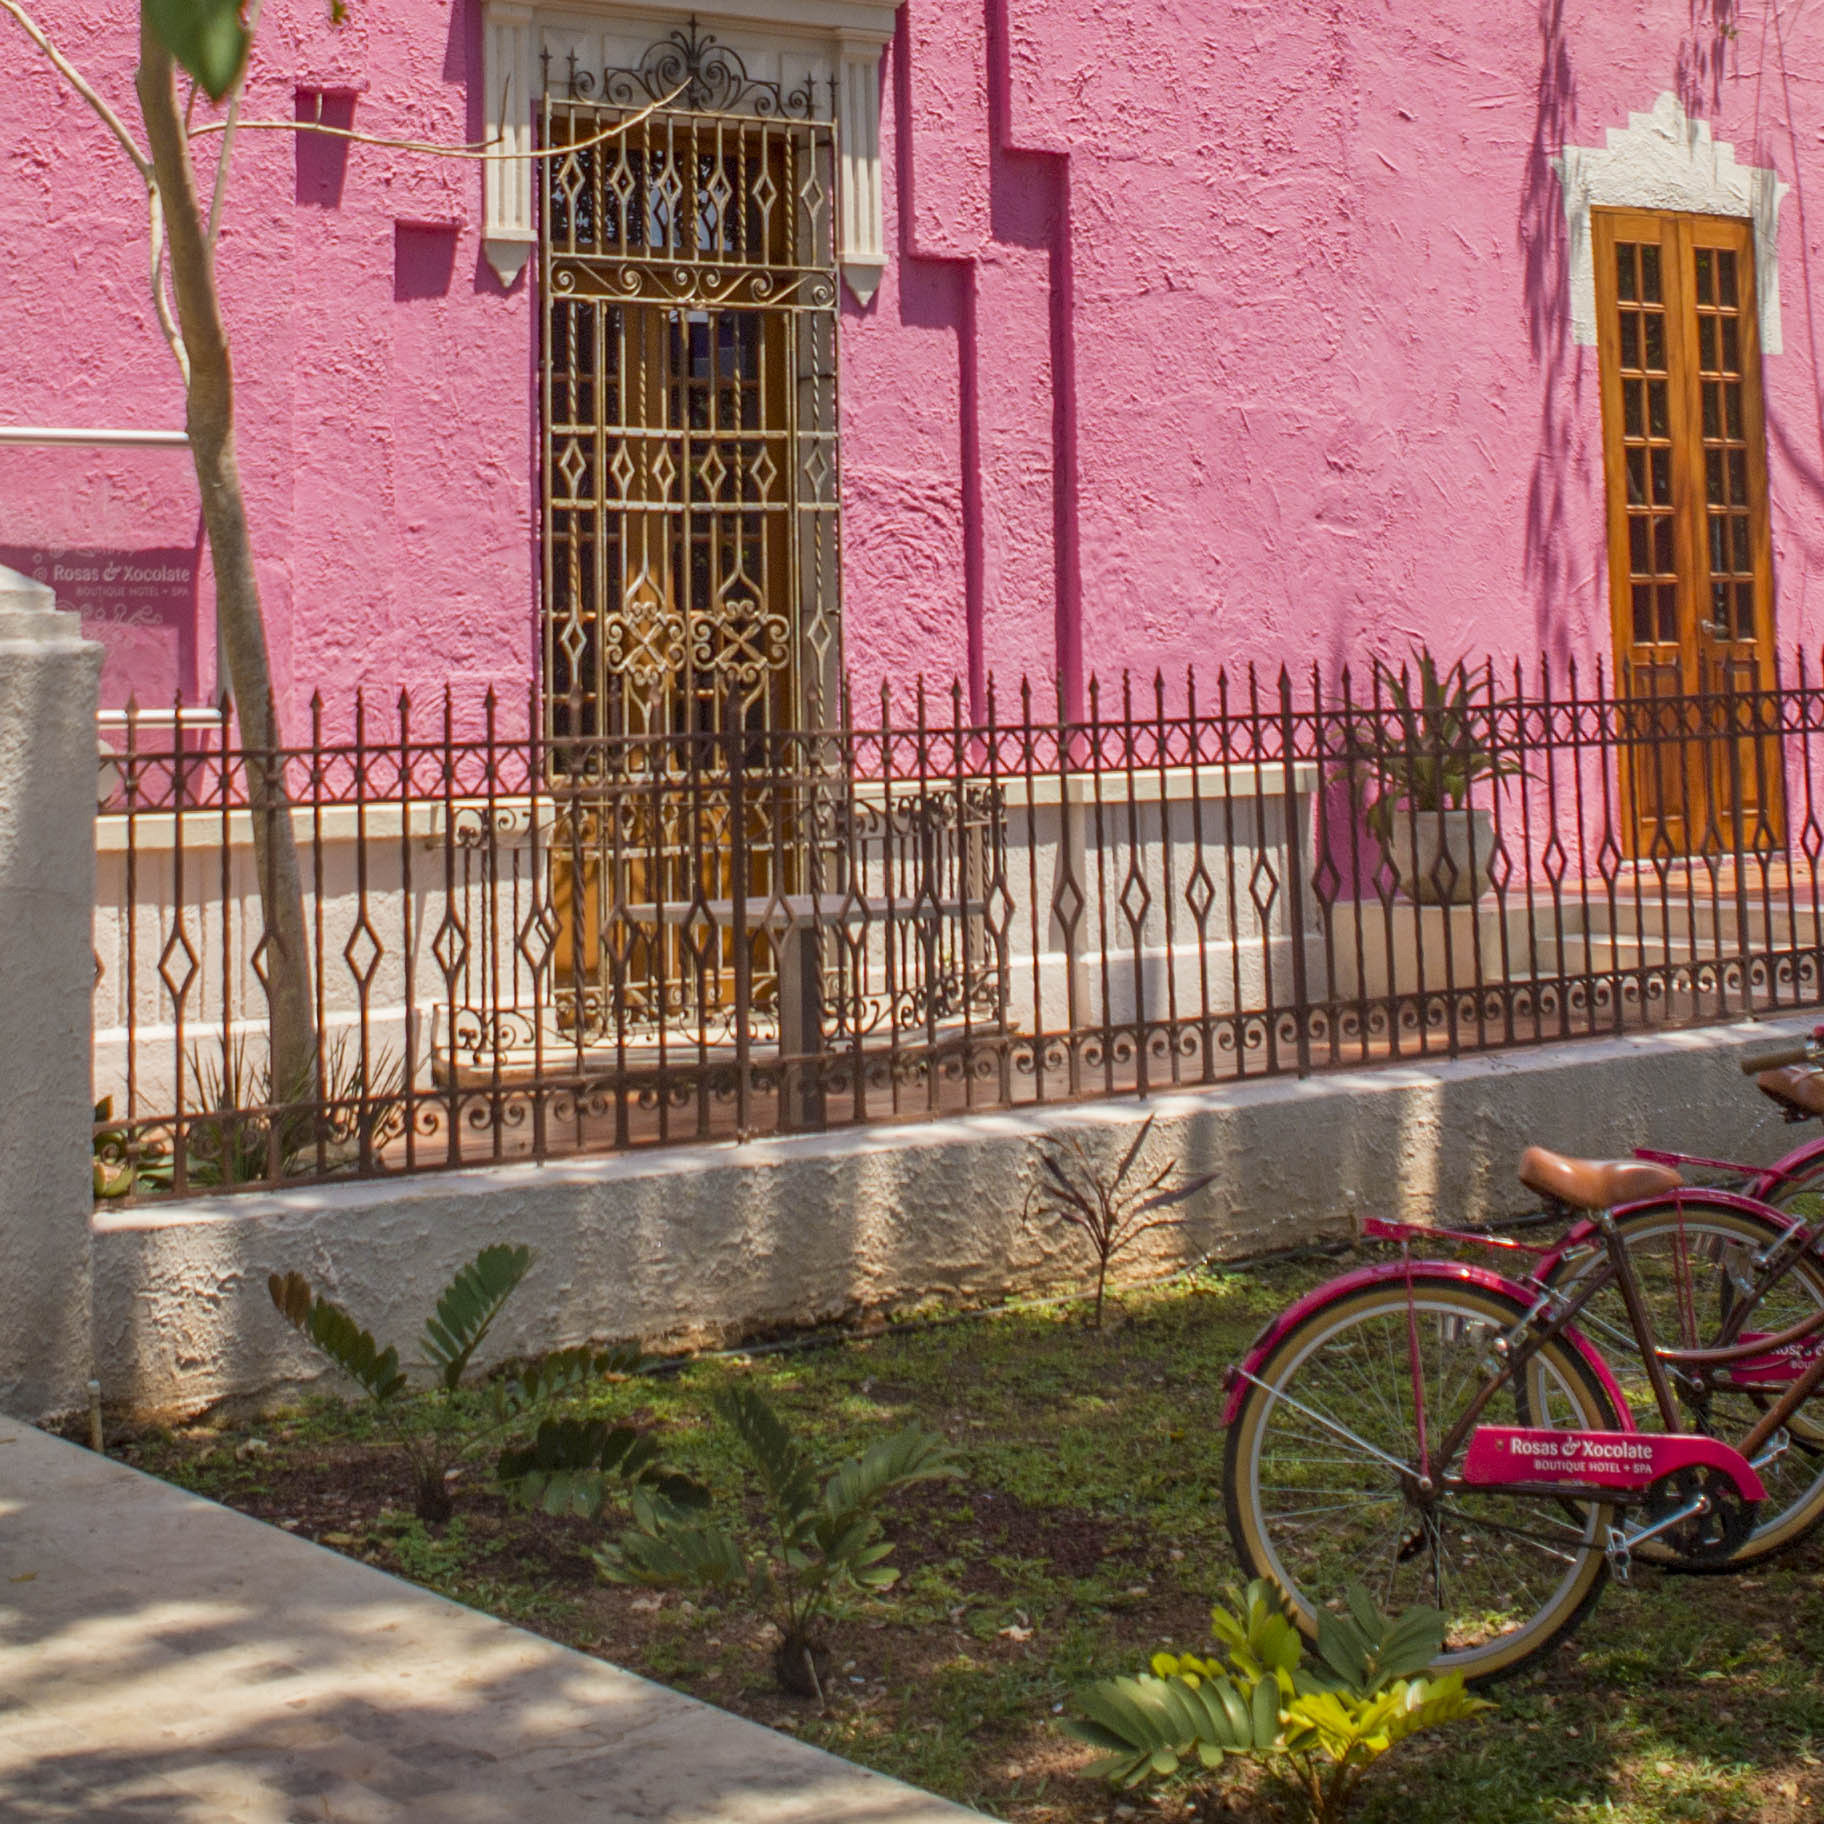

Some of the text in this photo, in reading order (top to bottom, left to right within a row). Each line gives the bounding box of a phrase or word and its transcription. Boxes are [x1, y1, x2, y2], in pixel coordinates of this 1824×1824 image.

[54, 564, 99, 582] Rosas
[124, 564, 191, 583] Xocolate
[129, 586, 160, 597] HOTEL
[1510, 1437, 1558, 1456] Rosas
[1582, 1440, 1653, 1460] Xocolate
[1534, 1459, 1585, 1474] BOUTIQUE
[1589, 1460, 1621, 1474] HOTEL
[1633, 1463, 1653, 1475] SPA
